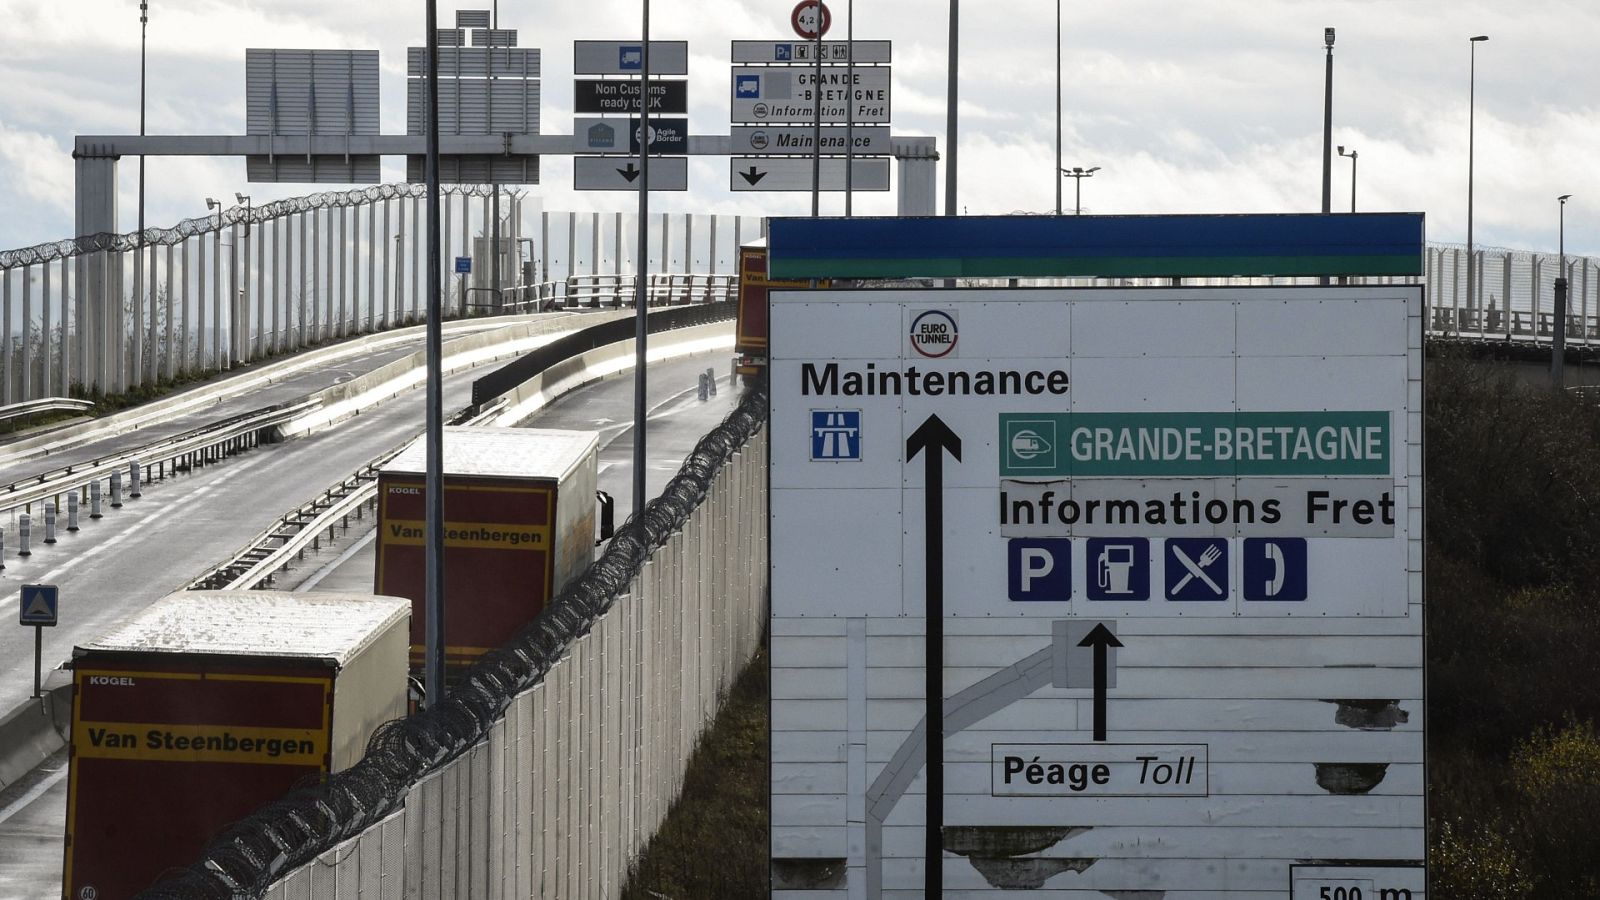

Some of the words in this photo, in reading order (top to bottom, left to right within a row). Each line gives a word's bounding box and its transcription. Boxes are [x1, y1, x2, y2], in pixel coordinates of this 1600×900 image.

[798, 15, 823, 25] 4,2
[798, 74, 860, 85] GRANDE
[595, 83, 617, 95] Non
[619, 83, 667, 95] Cusms
[600, 97, 630, 110] ready
[771, 106, 846, 116] Informtion
[858, 106, 884, 116] Fret
[776, 134, 871, 147] Mainenace
[921, 323, 947, 334] EURO
[915, 334, 952, 344] TUNNEL
[801, 362, 1070, 396] Maintenance
[1070, 426, 1383, 462] GRANDE-BRETAGNE
[1000, 491, 1282, 525] Informations
[1306, 490, 1396, 525] Fret
[390, 524, 423, 539] Van
[441, 526, 542, 545] teenbergen
[88, 727, 138, 749] Van
[146, 730, 315, 757] Steenbergen
[1004, 755, 1111, 792] Péage
[1135, 756, 1196, 785] Toll
[1319, 886, 1363, 900] 500
